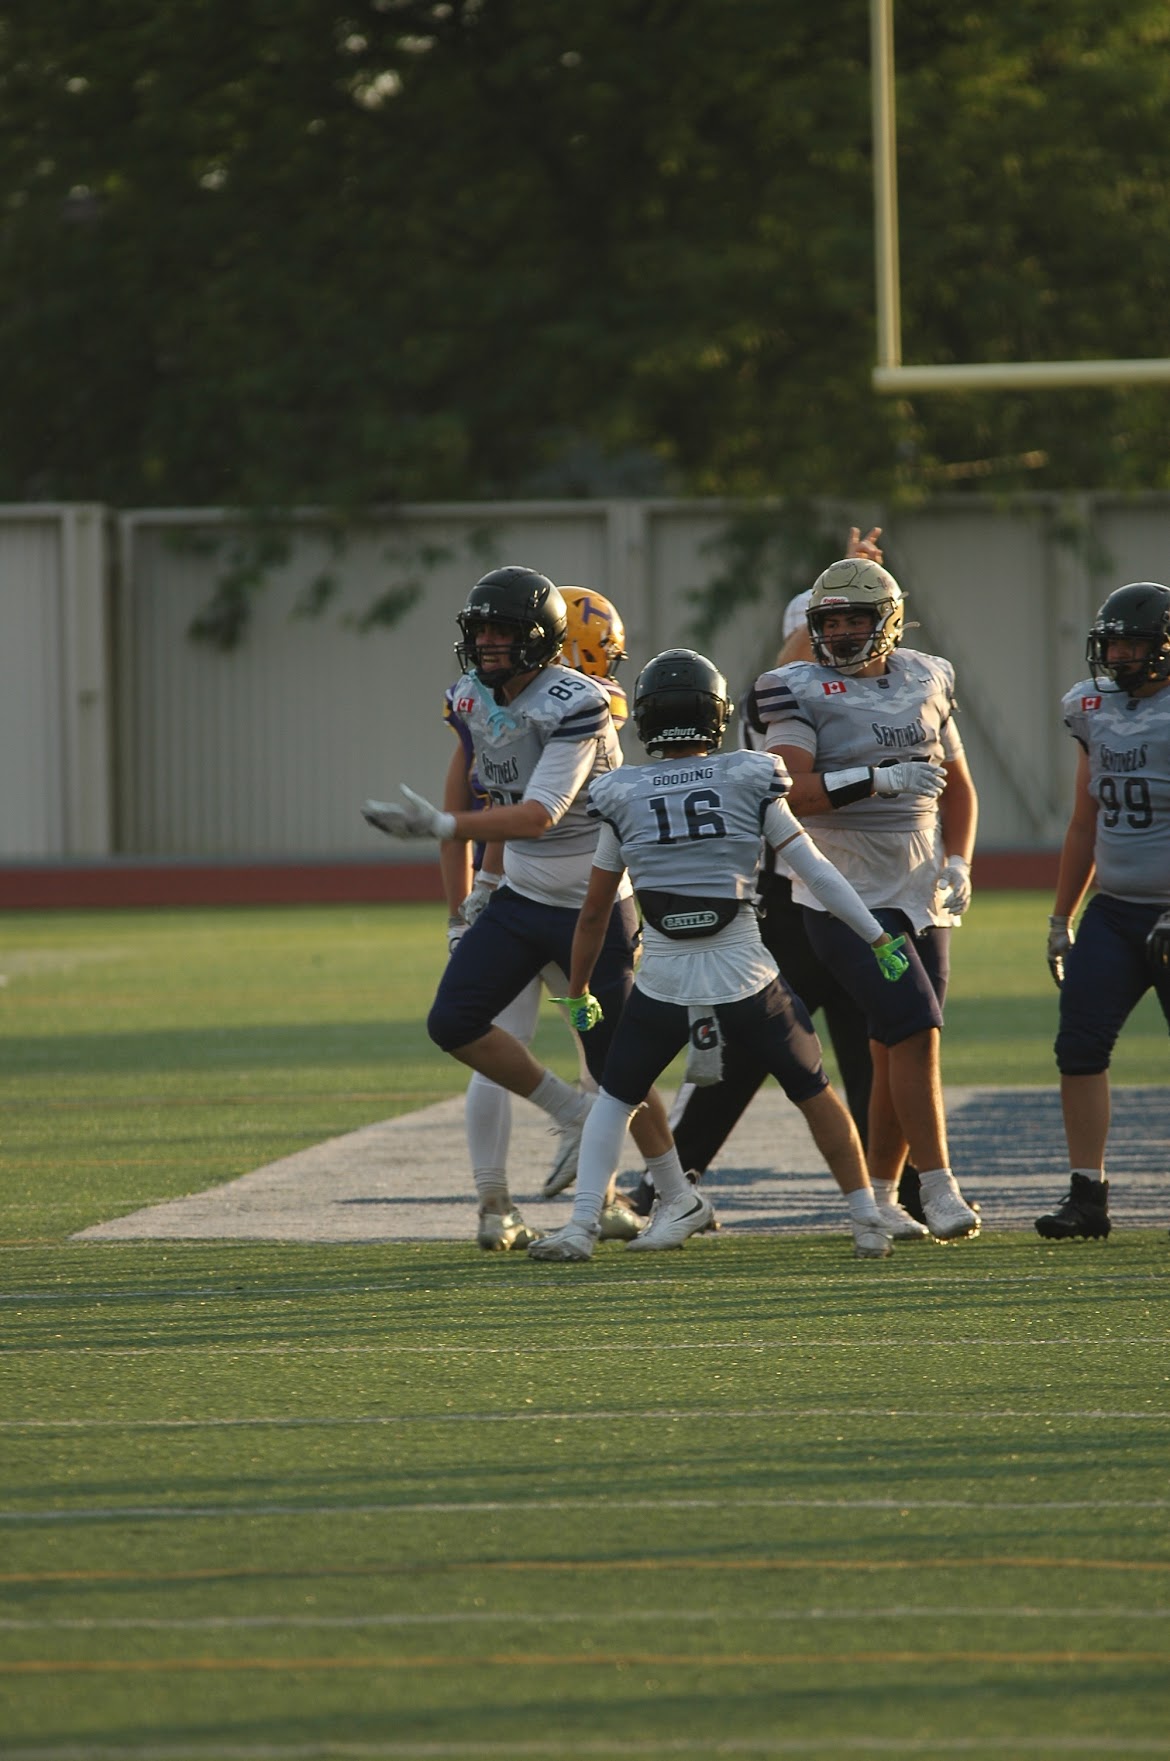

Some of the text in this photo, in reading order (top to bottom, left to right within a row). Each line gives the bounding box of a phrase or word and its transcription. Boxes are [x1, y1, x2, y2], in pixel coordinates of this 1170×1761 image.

[547, 677, 586, 701] 85
[662, 727, 696, 737] schutt
[871, 718, 927, 747] SENTINELS
[482, 752, 519, 784] SENTINELS
[653, 767, 713, 786] GOODING
[649, 788, 726, 844] 16
[1099, 777, 1153, 829] 99
[666, 914, 713, 928] BATTLE
[692, 1016, 718, 1050] G
